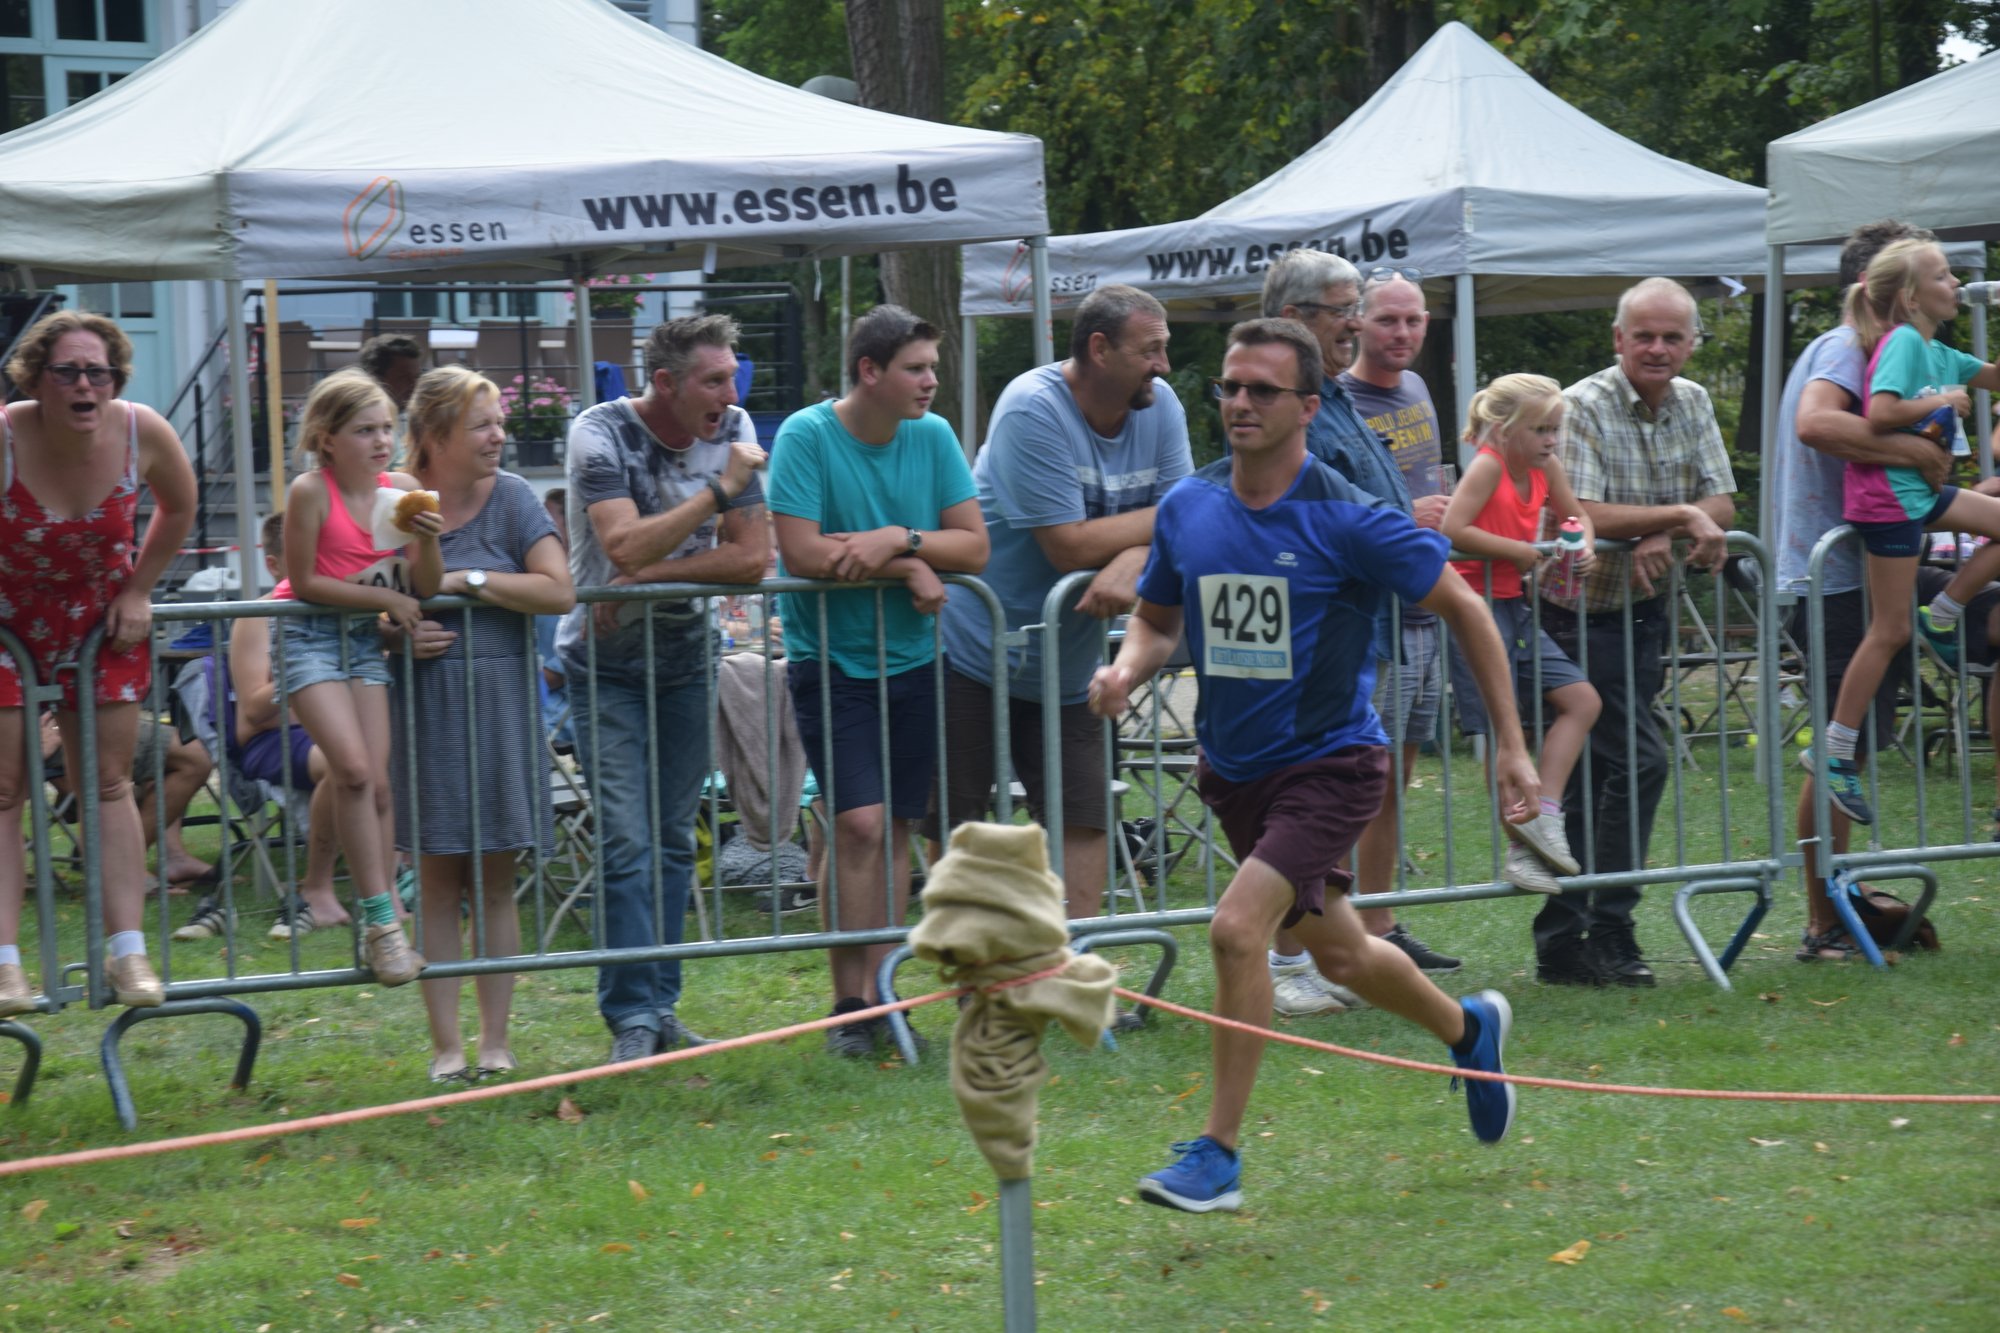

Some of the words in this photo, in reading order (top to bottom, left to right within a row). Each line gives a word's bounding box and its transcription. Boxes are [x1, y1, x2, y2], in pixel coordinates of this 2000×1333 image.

[583, 164, 957, 231] www.essen.be
[410, 221, 507, 244] essen
[1050, 271, 1097, 293] ssen
[1210, 582, 1283, 645] 429
